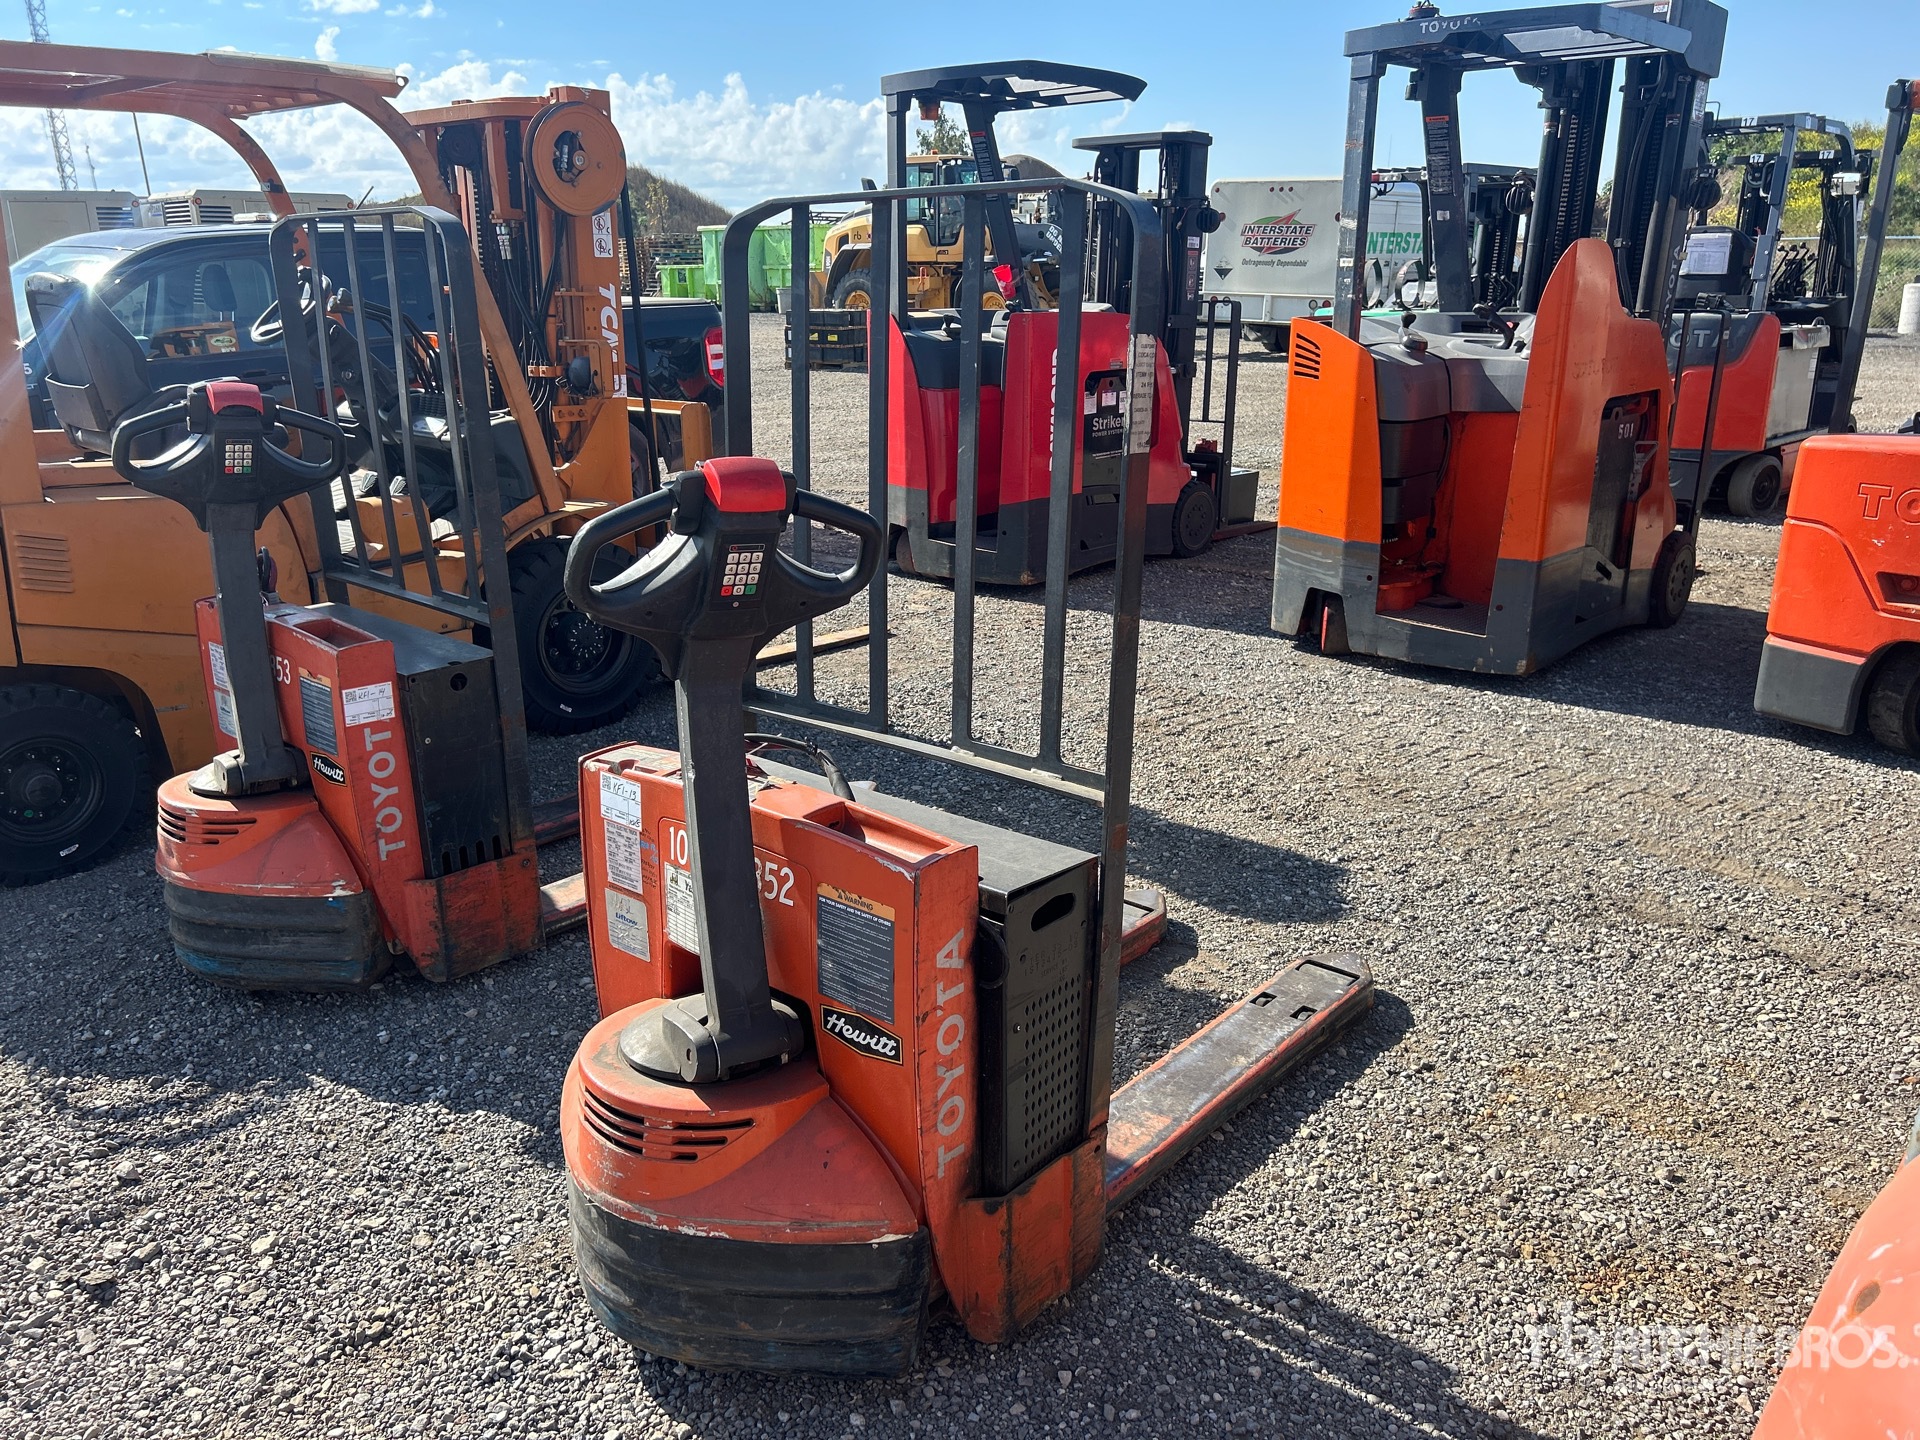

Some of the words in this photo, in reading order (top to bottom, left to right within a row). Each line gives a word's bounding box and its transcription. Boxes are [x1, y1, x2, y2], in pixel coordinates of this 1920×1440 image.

[1742, 117, 1754, 126] 17
[1751, 154, 1761, 163] 17
[1820, 151, 1831, 159] 17
[853, 231, 862, 240] rb
[1243, 225, 1314, 235] INTERSTATE
[1046, 231, 1062, 255] UNDE
[1243, 236, 1307, 247] BATTERIES
[1241, 258, 1276, 268] Outrageously
[1092, 430, 1108, 438] POWER
[1618, 423, 1634, 440] 501
[313, 756, 344, 782] Hewitt
[363, 727, 406, 862] TOYOT
[844, 894, 874, 911] WARNING
[835, 902, 847, 910] SAFETY
[861, 912, 873, 920] SAFETY
[827, 1013, 897, 1056] Hewitt
[936, 928, 965, 1180] TOYOTA
